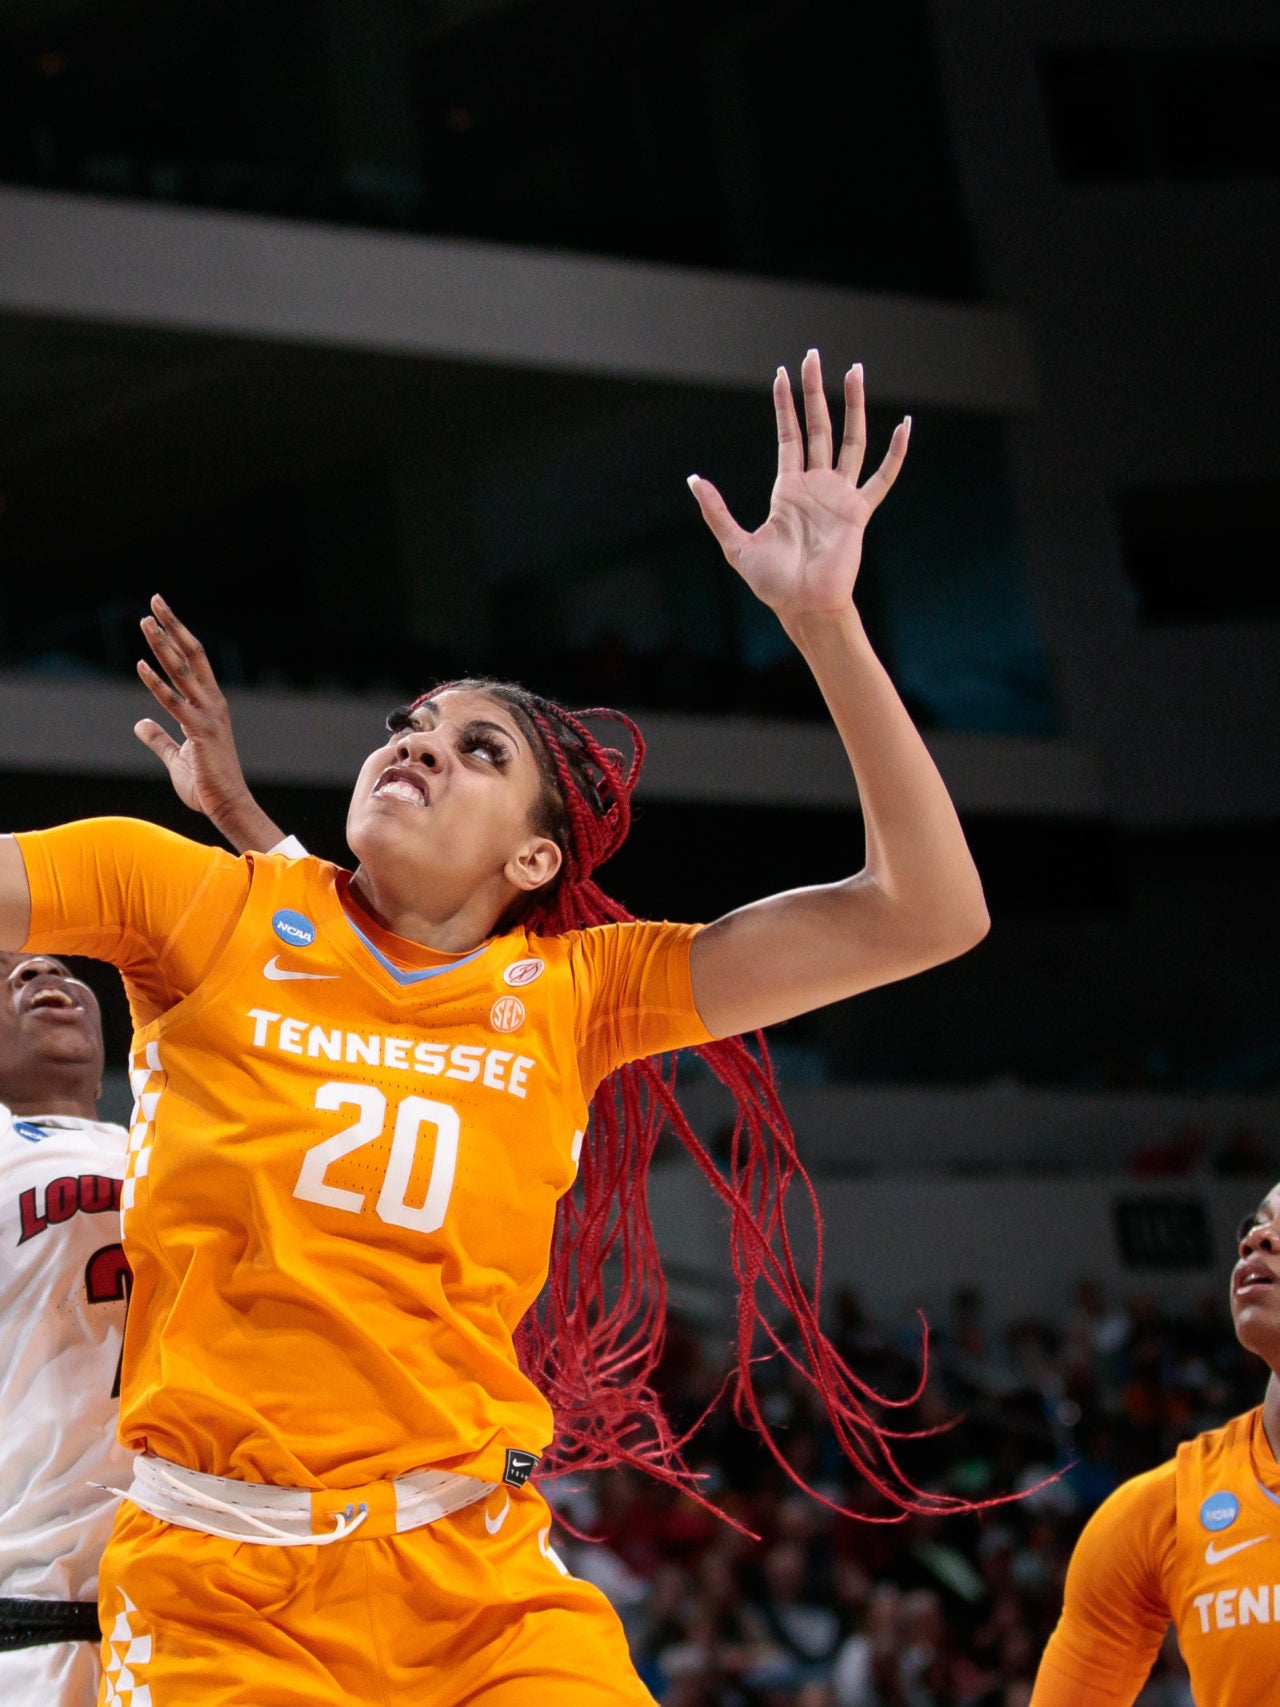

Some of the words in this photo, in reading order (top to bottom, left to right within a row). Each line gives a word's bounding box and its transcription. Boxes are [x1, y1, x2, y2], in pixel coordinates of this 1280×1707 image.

[277, 921, 312, 942] NCAA
[493, 998, 524, 1029] SEC
[246, 1008, 536, 1099] TENNESSEE
[292, 1081, 461, 1234] 20
[1193, 1584, 1280, 1634] TEN
